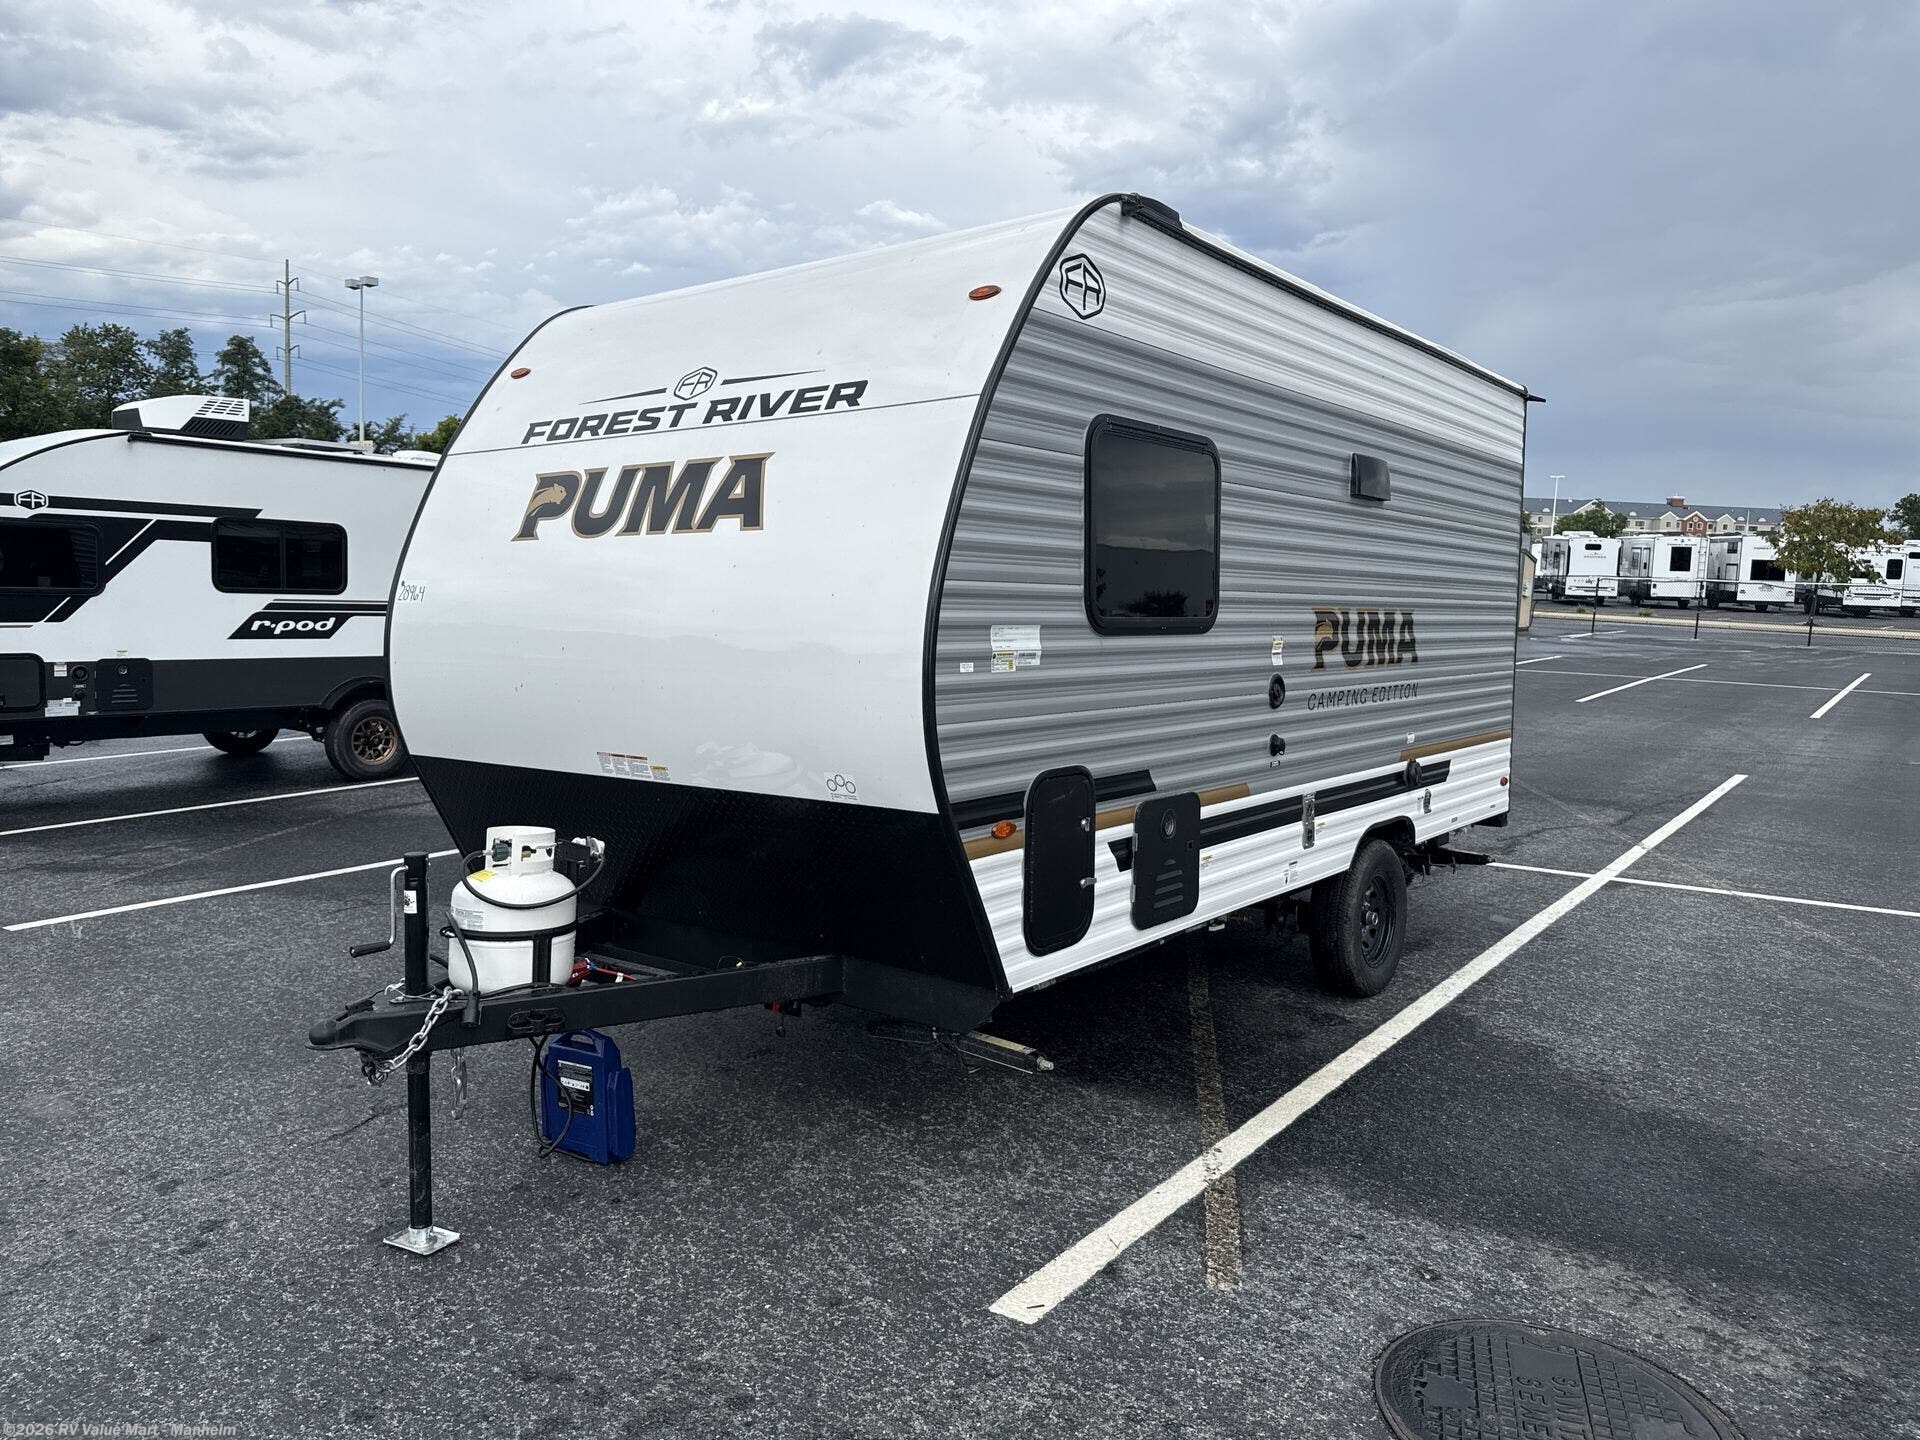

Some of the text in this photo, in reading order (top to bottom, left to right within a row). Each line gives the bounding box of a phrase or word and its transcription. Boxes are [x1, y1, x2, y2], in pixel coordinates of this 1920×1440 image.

[521, 379, 869, 444] FOREST RIVER
[511, 451, 776, 541] PUMA
[1311, 607, 1419, 672] PUMA
[1307, 682, 1419, 711] CAMPING EDITION
[1516, 1376, 1551, 1440] SEWE
